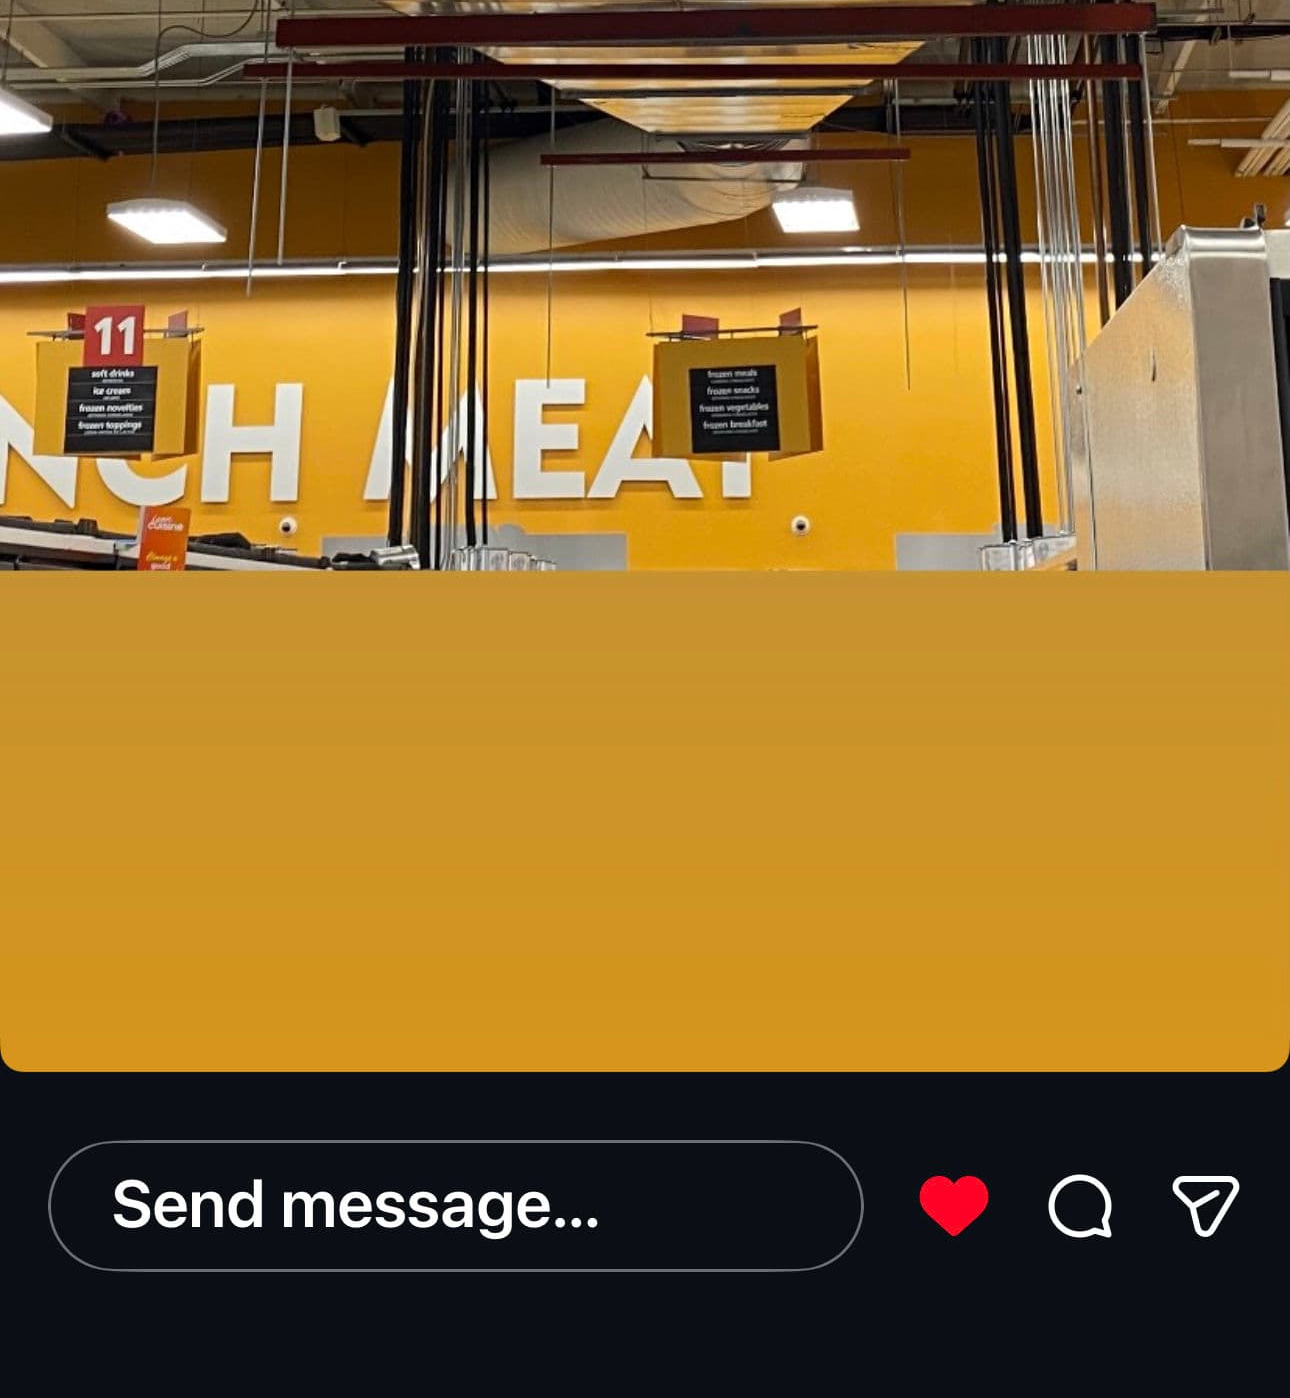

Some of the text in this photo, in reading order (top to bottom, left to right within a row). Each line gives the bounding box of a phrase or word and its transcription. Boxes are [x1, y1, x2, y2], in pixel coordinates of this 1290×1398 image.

[94, 316, 136, 355] 11
[91, 369, 135, 378] soft drinks
[707, 370, 732, 378] frozen
[93, 386, 131, 395] ice cream
[707, 386, 760, 395] frozen snacks
[79, 403, 143, 413] frozen novelties
[699, 404, 725, 412] frozen
[727, 403, 768, 415] vegetables
[78, 420, 104, 430] frozen
[106, 420, 142, 433] toppings
[703, 419, 767, 429] frozen breakfast
